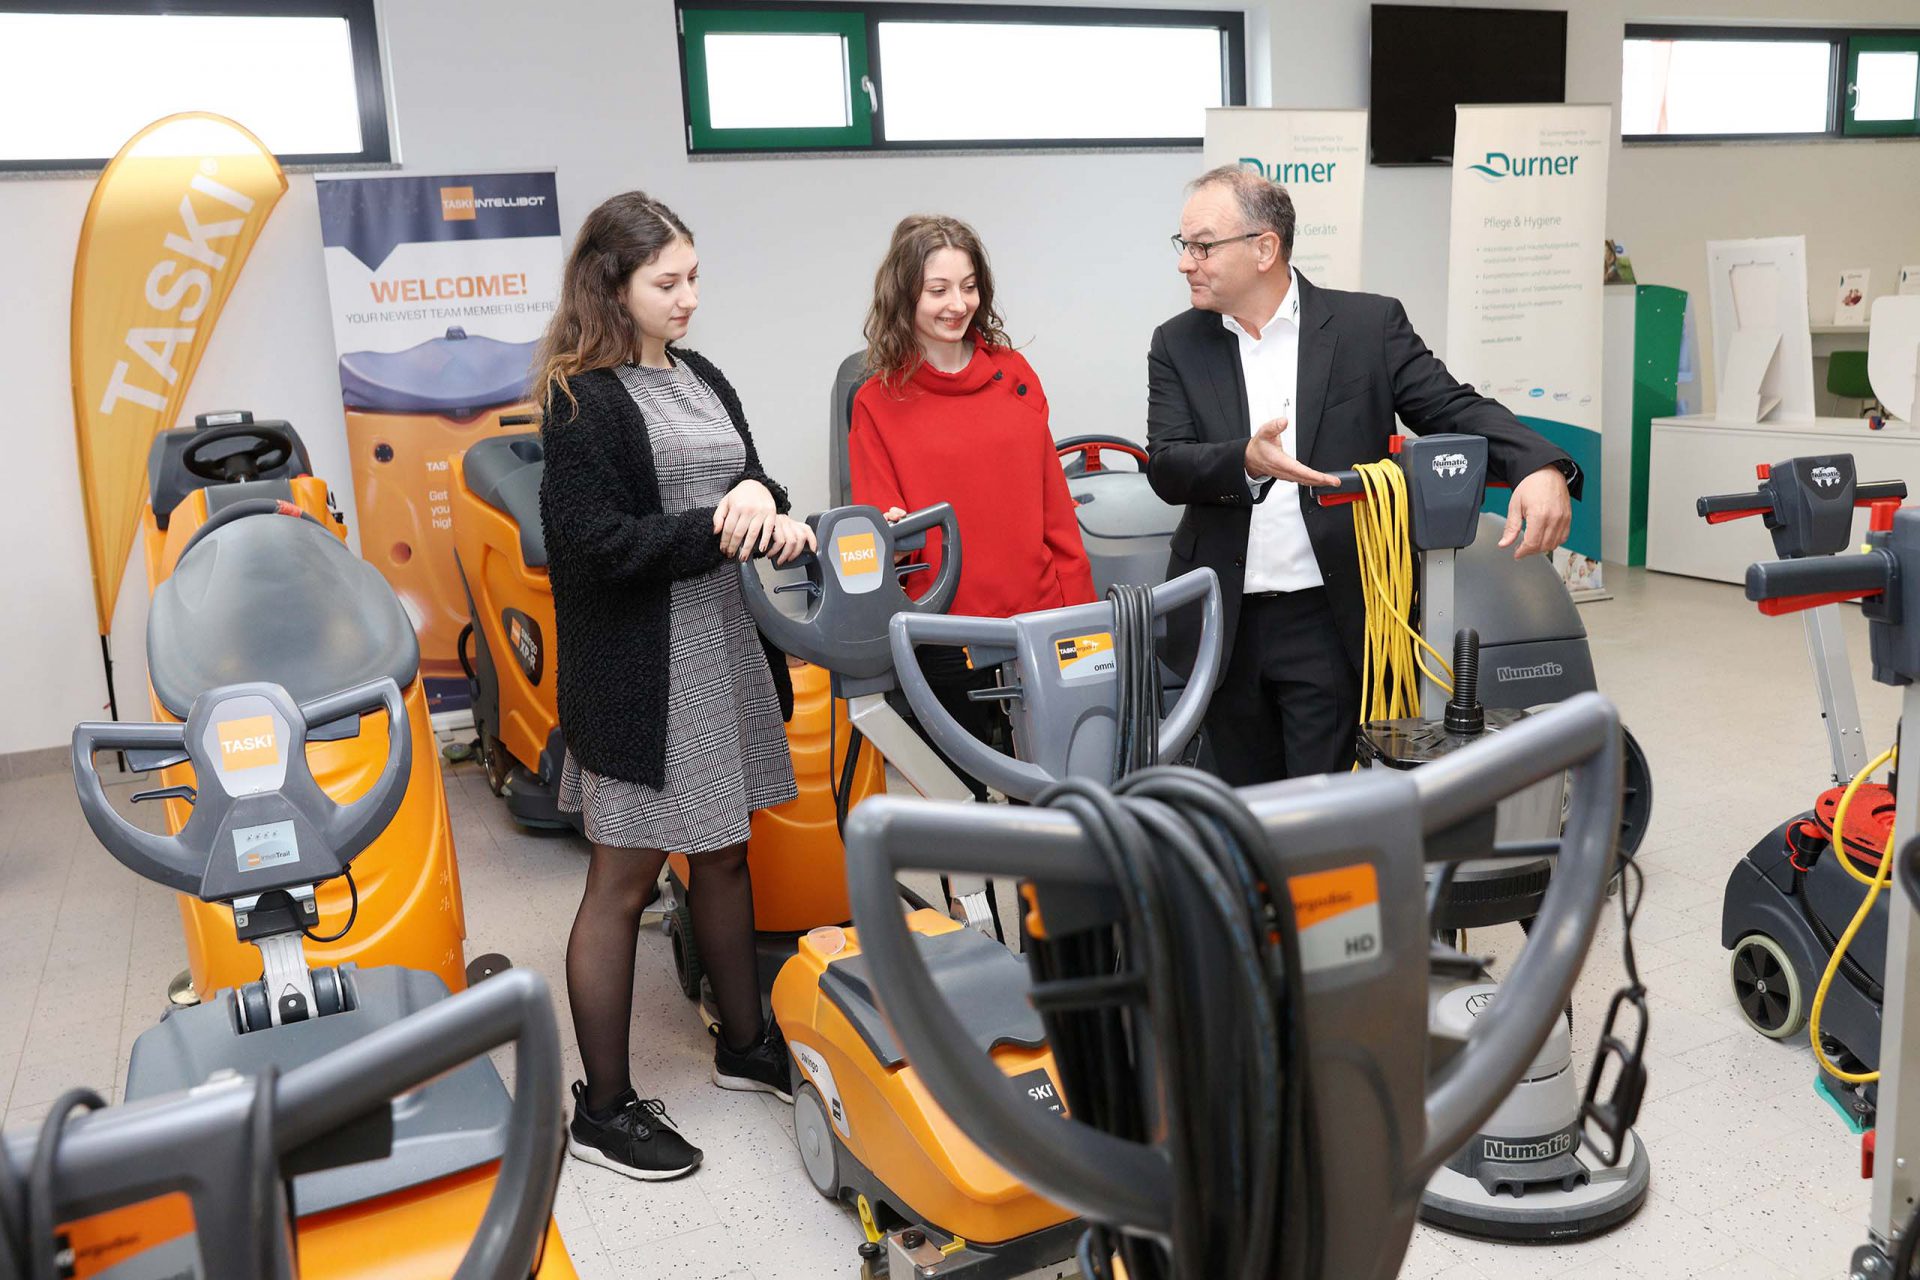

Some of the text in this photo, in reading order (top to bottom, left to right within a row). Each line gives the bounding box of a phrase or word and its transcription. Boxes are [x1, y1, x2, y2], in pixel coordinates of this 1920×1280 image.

[1484, 152, 1579, 177] Durner
[442, 196, 546, 210] TASKI INTELLIBOT
[1303, 223, 1338, 236] Geräte
[1483, 216, 1562, 231] Pflege & Hygiene
[370, 273, 528, 303] WELCOME!
[346, 301, 555, 324] YOUR NEWEST TEAM MEMBER IS HERE
[426, 461, 449, 472] TAS
[1433, 459, 1467, 468] Numatic
[1811, 471, 1839, 479] Numatic
[429, 490, 449, 502] Get
[841, 547, 875, 563] TASKI
[520, 638, 537, 671] XP-R
[1060, 647, 1077, 655] TASKI
[1094, 660, 1115, 671] omni
[1497, 662, 1563, 682] Numatic
[221, 733, 273, 753] TASKI
[1344, 933, 1376, 957] HD
[802, 1052, 819, 1073] swingo
[1027, 1083, 1054, 1101] SKI
[1484, 1132, 1571, 1162] Numatic
